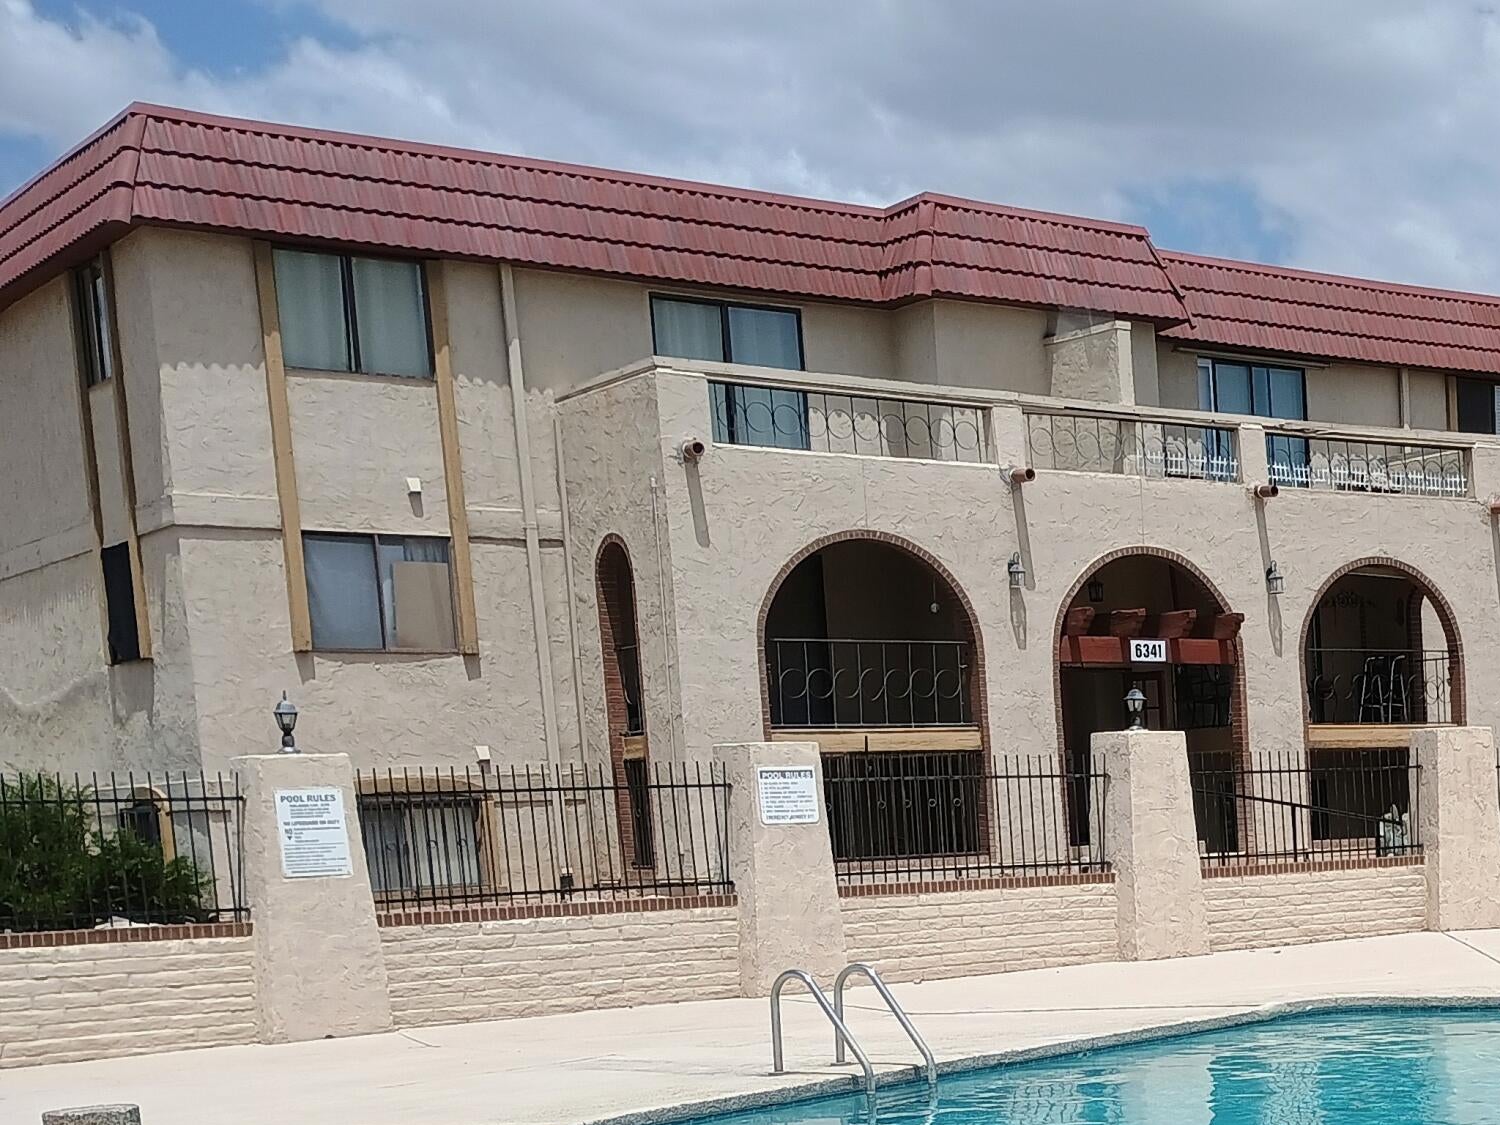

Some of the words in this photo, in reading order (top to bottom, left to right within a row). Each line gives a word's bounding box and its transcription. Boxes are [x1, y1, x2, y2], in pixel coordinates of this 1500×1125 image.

[1135, 643, 1162, 659] 6341
[785, 771, 811, 779] RULES
[280, 795, 304, 803] POOL
[306, 794, 337, 802] RULES
